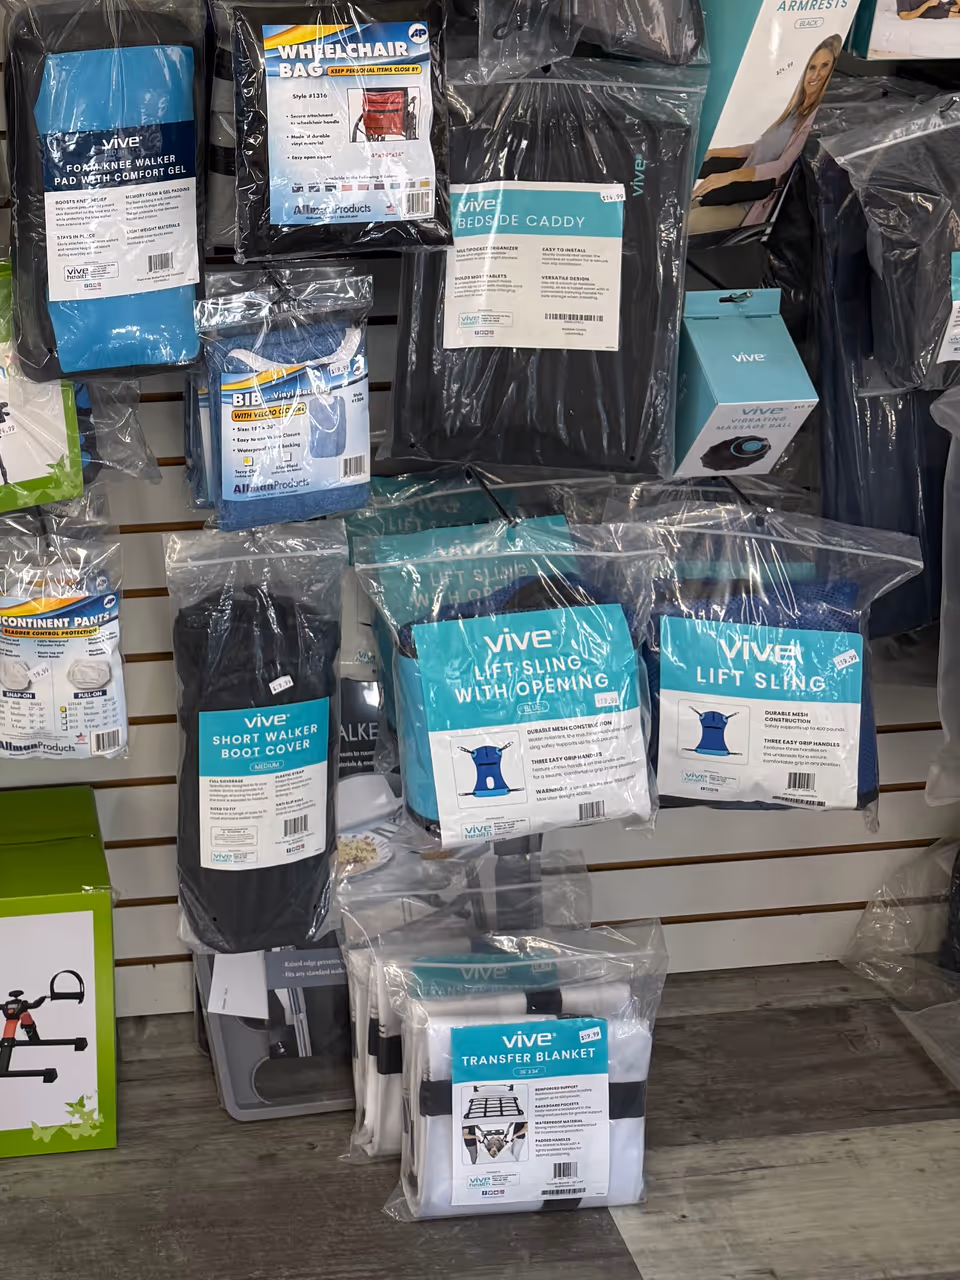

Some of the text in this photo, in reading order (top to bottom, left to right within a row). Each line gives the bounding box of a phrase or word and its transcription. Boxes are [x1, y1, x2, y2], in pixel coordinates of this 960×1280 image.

[277, 42, 408, 59] WHEELCHAIR
[279, 63, 323, 77] BAG
[66, 155, 175, 173] FOAM KNEE WALKER
[55, 165, 186, 185] PAD WITH COMFORT GEL
[458, 198, 496, 212] vive
[458, 215, 585, 228] BEDSIDE CADDY
[732, 352, 764, 362] vive
[233, 393, 261, 406] BIB
[74, 612, 110, 625] PANTS
[484, 628, 552, 653] vive
[475, 655, 581, 680] LIFT SLING
[455, 673, 608, 703] WITH OPENING
[696, 667, 826, 691] LIFT SLING
[213, 725, 318, 745] SHORT WALKER
[221, 740, 311, 759] BOOT COVER
[462, 1048, 596, 1066] TRANSFER BLANKET
